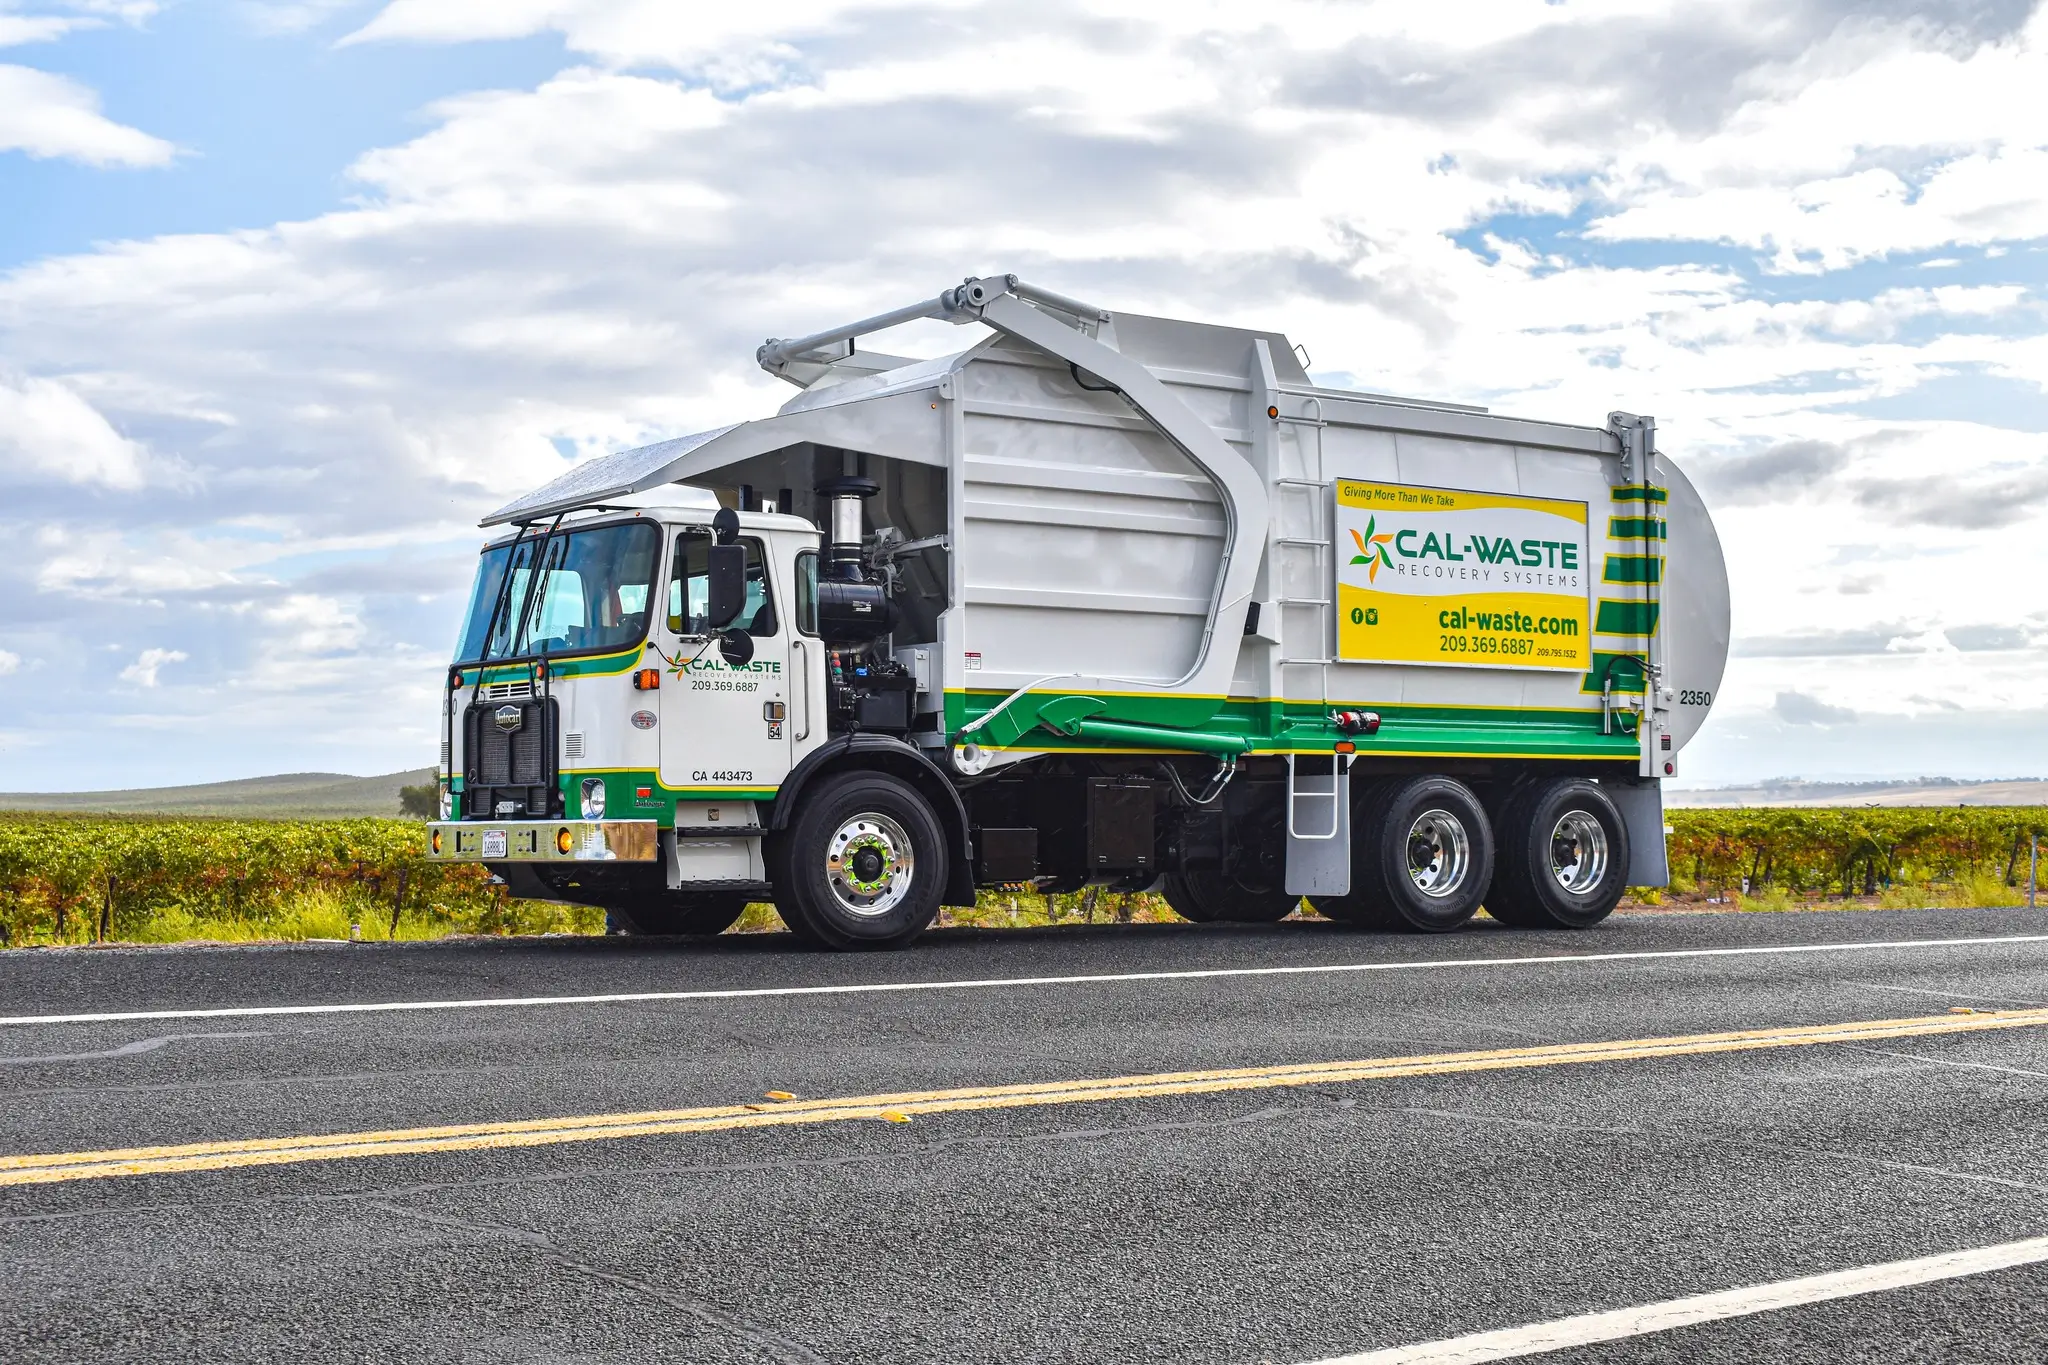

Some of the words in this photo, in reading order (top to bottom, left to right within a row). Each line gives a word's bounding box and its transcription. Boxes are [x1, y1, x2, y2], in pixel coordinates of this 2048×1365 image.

[1344, 485, 1372, 500] Giving
[1374, 489, 1395, 501] More
[1398, 491, 1418, 503] Than
[1420, 494, 1434, 505] We
[1436, 495, 1455, 507] Take
[1395, 529, 1578, 570] CAL-WASTE
[1398, 563, 1490, 581] RECOVERY
[1503, 571, 1578, 587] SYSTEMS
[1439, 606, 1578, 636] cal-waste.com
[1440, 635, 1534, 656] 209.369.6887
[1536, 647, 1577, 659] 209.795.1532
[691, 658, 781, 673] CAL-WASTE
[693, 671, 738, 679] RECOVERY
[744, 673, 782, 681] SYSTEMS
[691, 680, 759, 692] 209.369.6887
[1680, 689, 1711, 706] 2350
[769, 726, 781, 738] 54
[692, 771, 708, 781] CA
[712, 771, 753, 781] 443473
